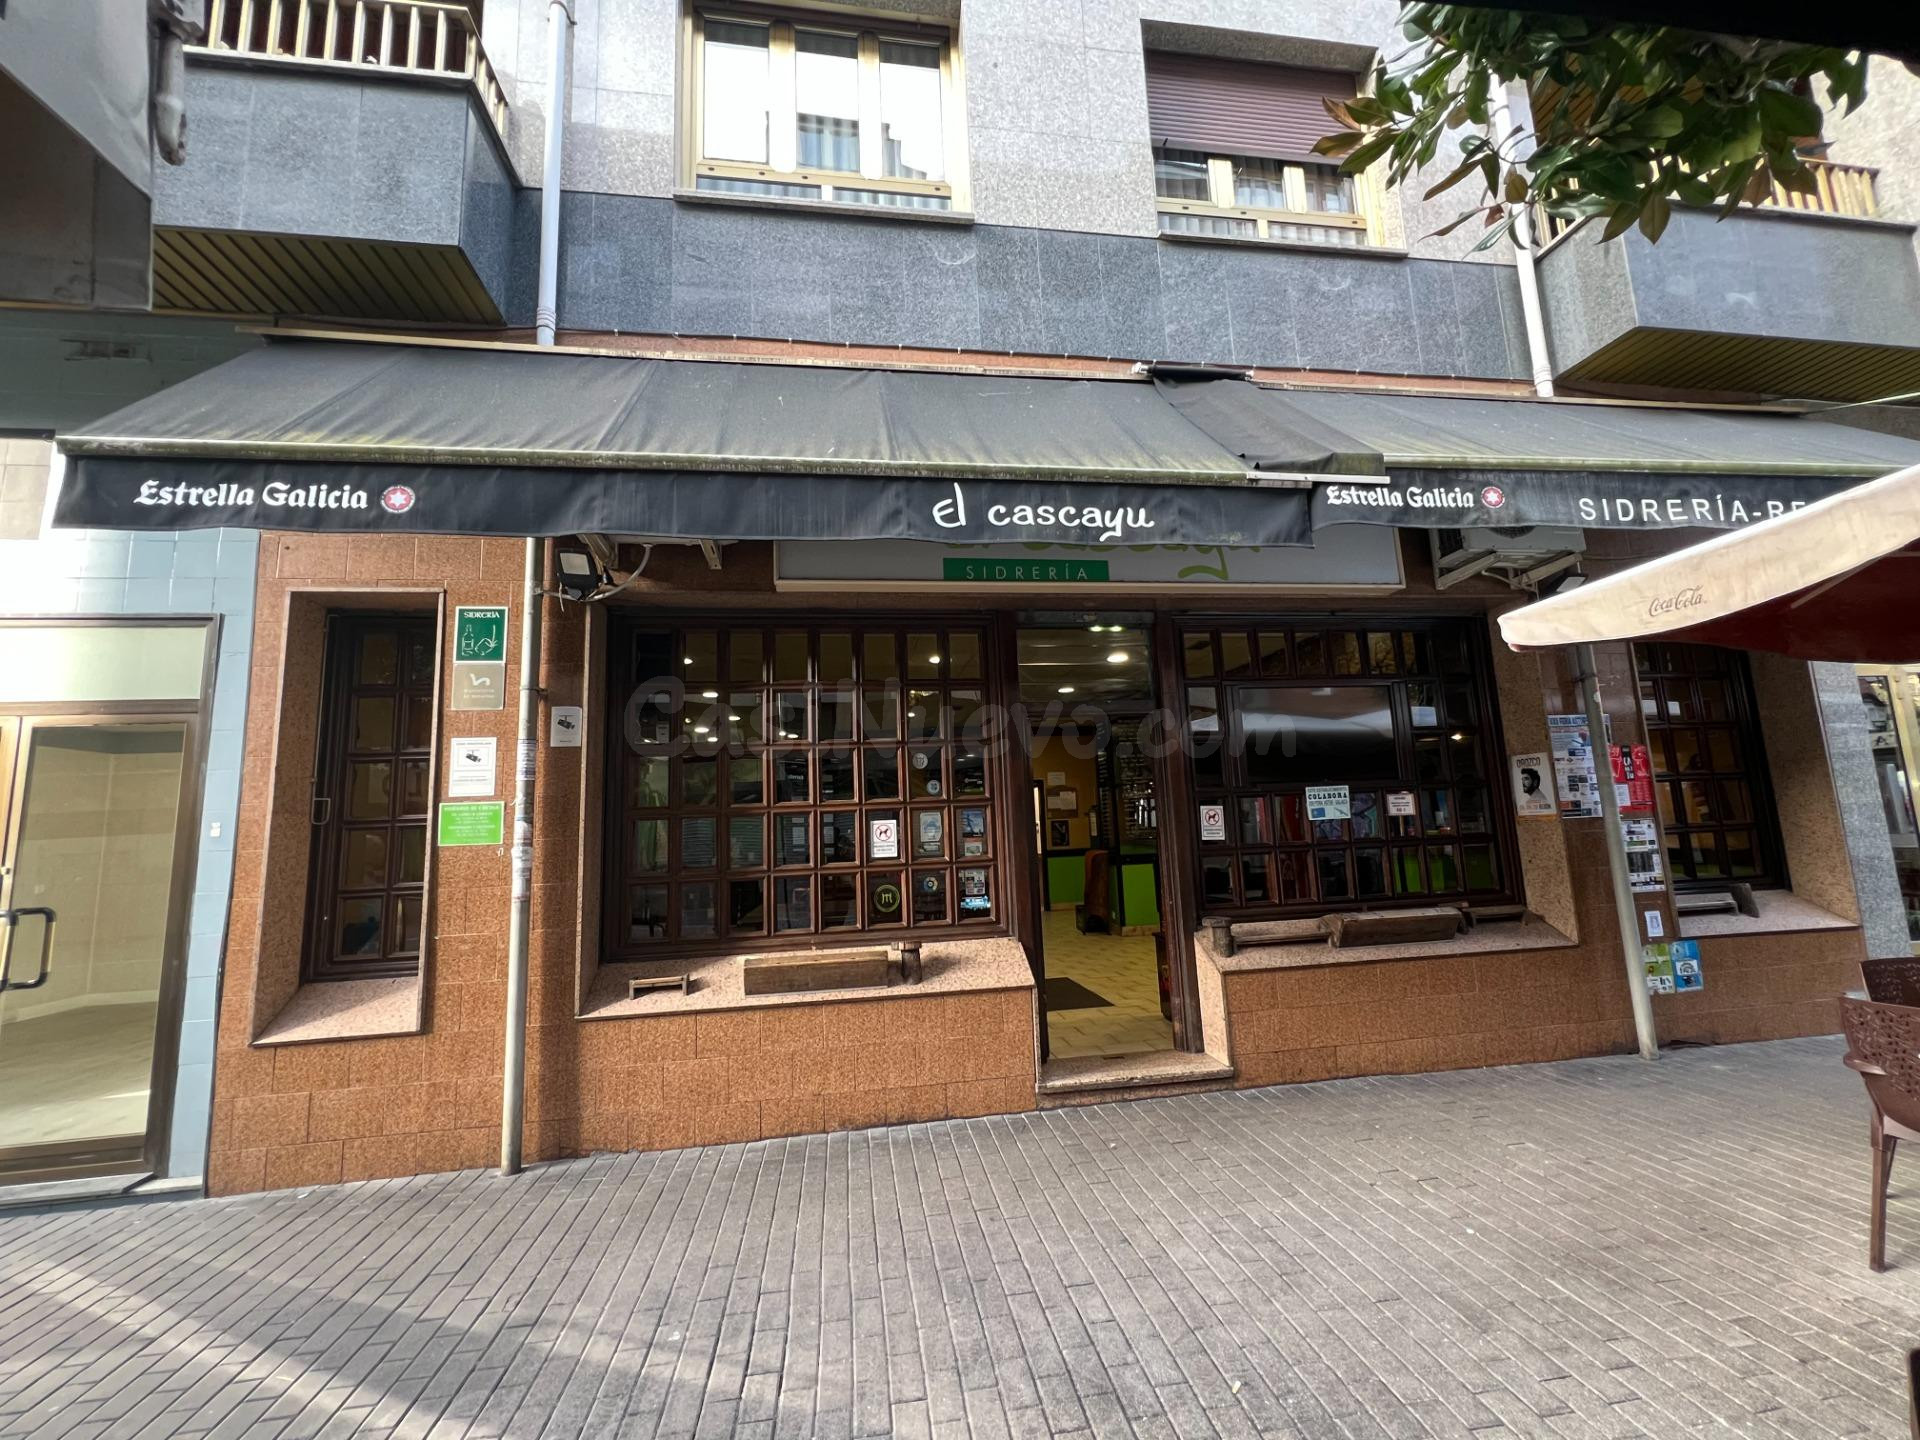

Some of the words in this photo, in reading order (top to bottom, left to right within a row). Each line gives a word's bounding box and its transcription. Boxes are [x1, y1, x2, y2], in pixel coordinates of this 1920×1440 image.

[133, 479, 255, 507] Estrella
[262, 482, 368, 509] Galicia
[1326, 486, 1404, 508] Estrella
[1406, 486, 1475, 509] Galicia
[988, 504, 1155, 542] cascayu
[966, 563, 1088, 581] SIDRERÍA
